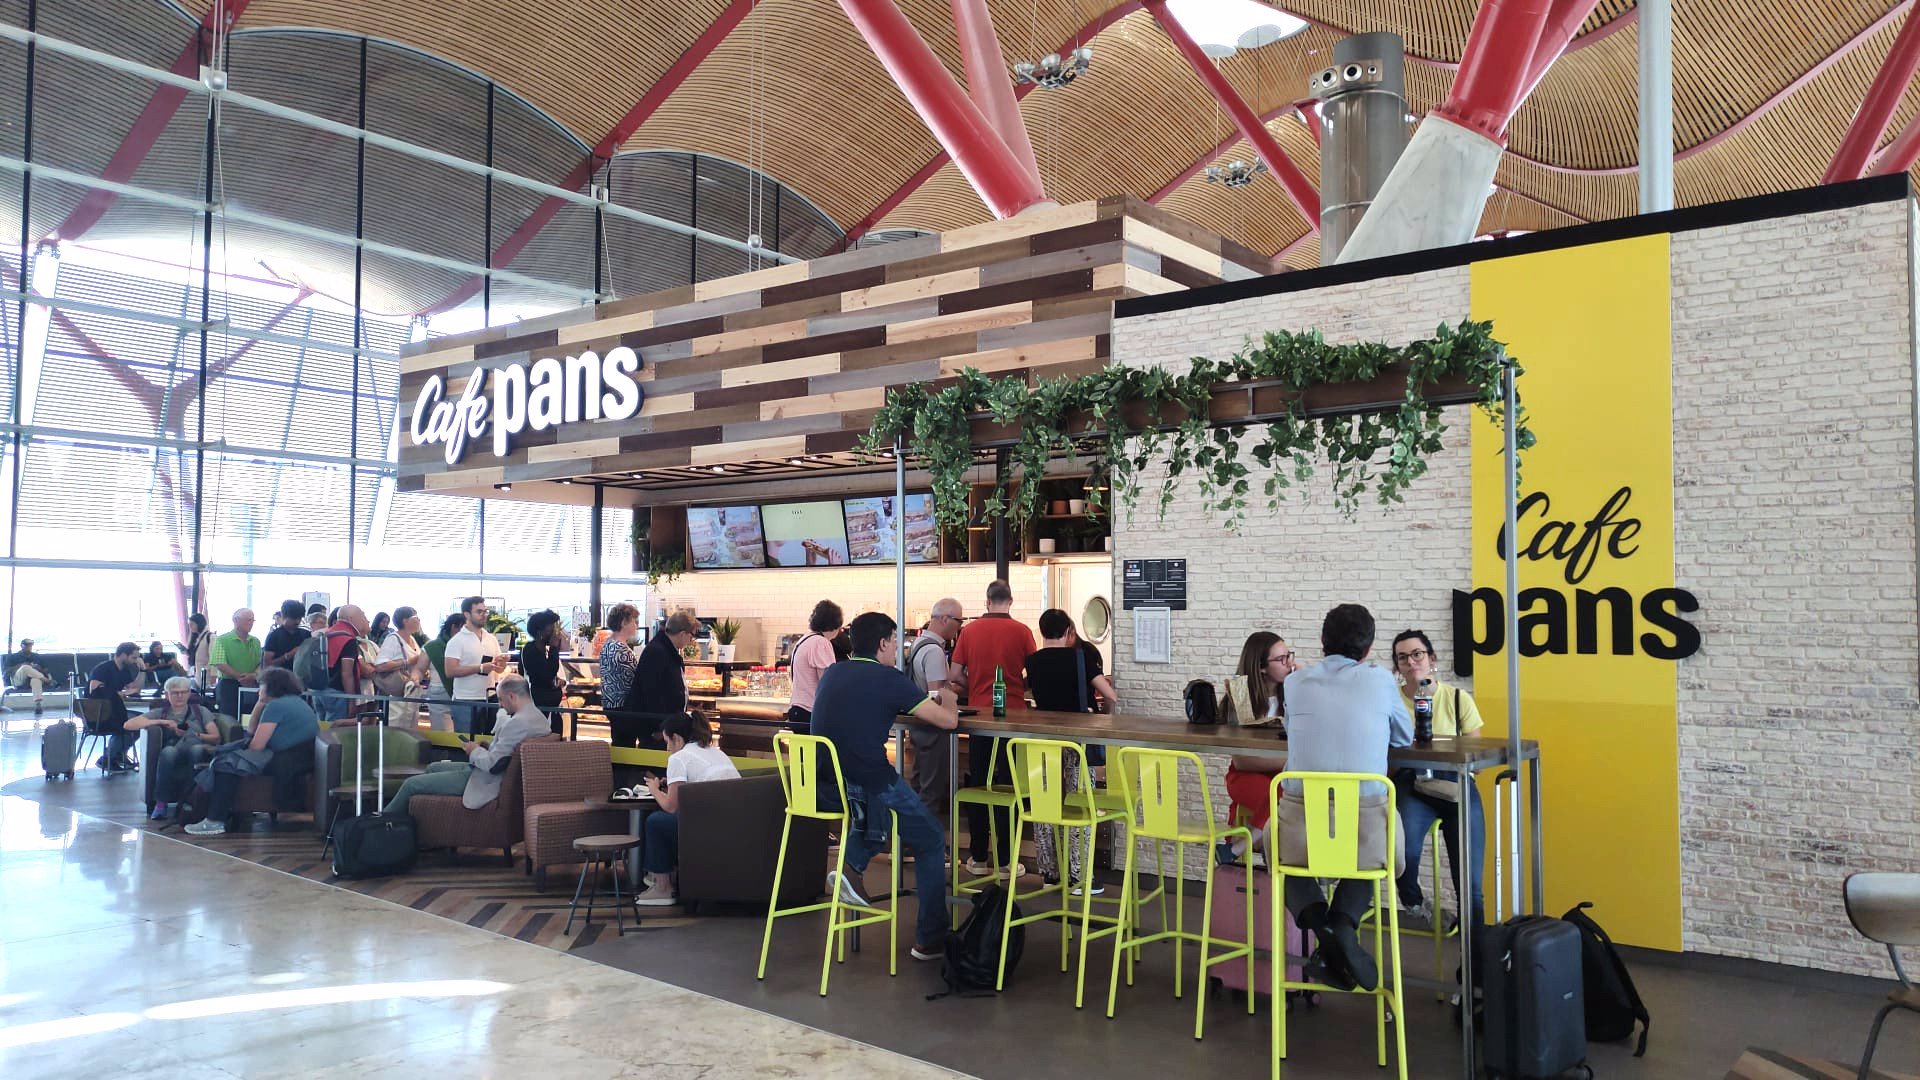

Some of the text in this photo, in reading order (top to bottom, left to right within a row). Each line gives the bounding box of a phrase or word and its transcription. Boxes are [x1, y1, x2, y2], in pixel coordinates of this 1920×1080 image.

[411, 346, 642, 465] Cafe pans
[1496, 486, 1642, 585] Cafe
[1452, 586, 1702, 678] pans
